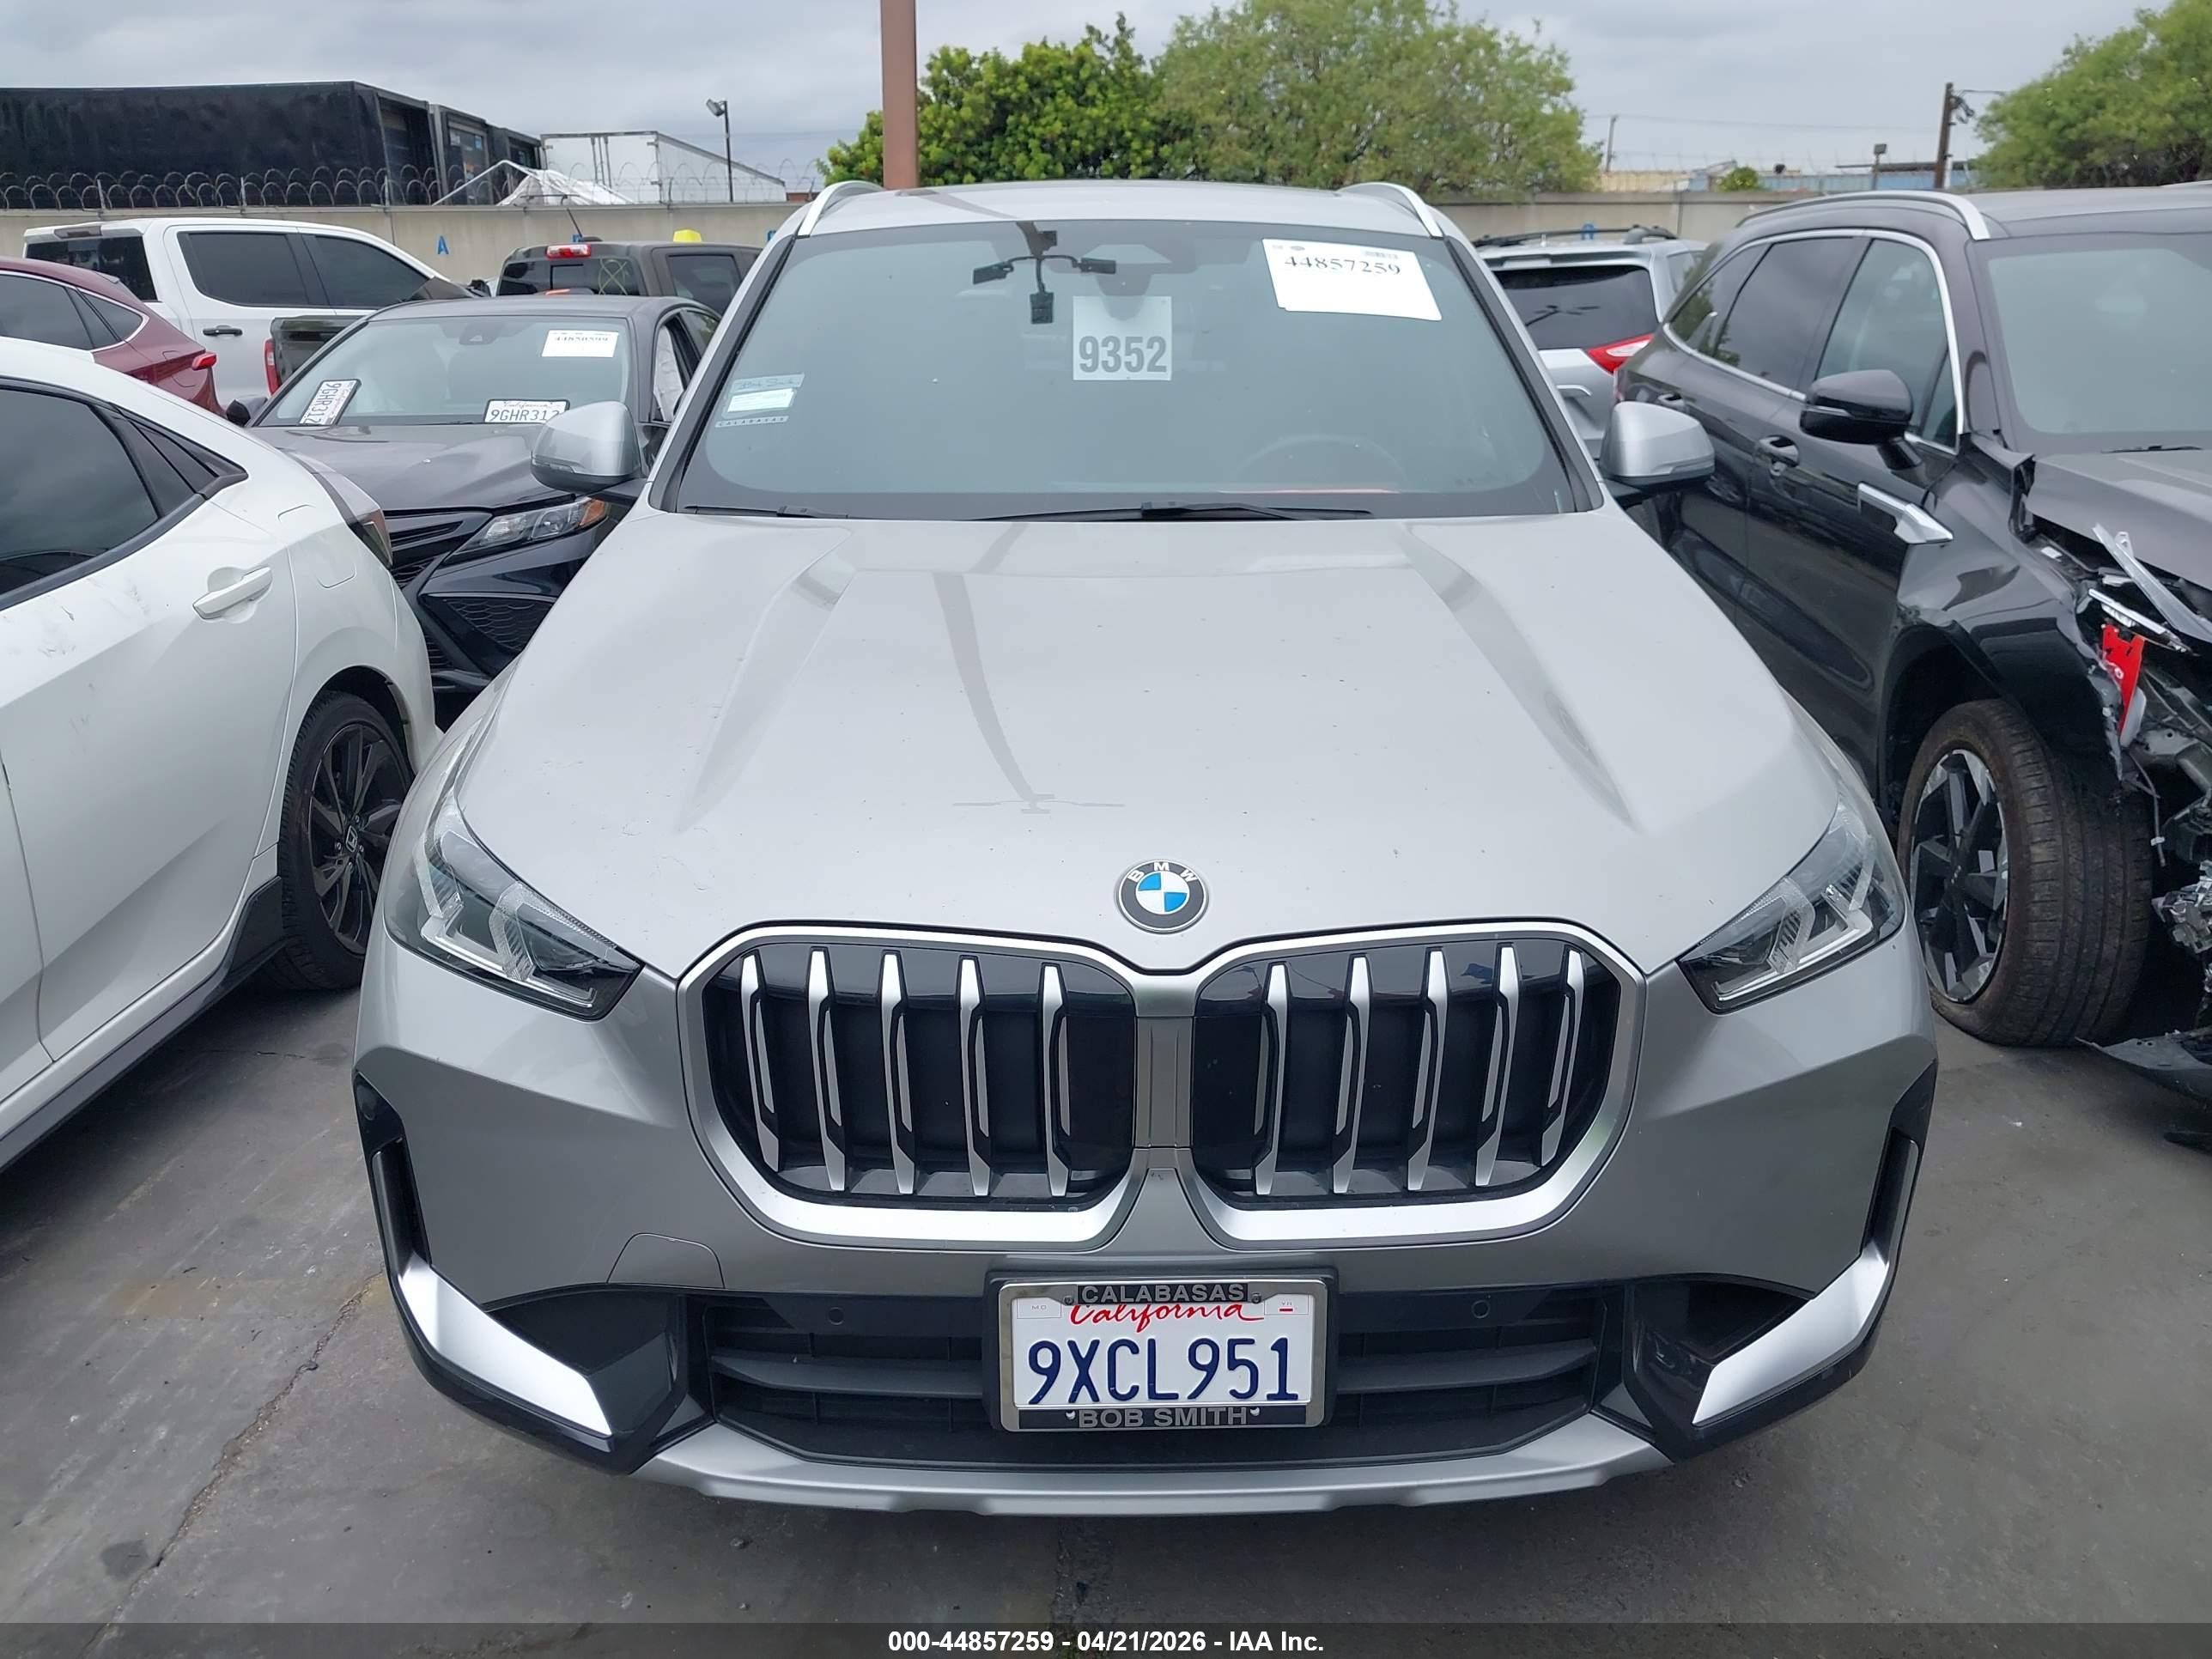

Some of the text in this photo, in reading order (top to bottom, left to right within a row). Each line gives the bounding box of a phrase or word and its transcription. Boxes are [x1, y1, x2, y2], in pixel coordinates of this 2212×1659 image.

[1284, 256, 1401, 276] 44857259
[1079, 335, 1167, 373] 9352
[1127, 861, 1198, 883] BMW
[1081, 1284, 1245, 1304] CALABASAS
[1027, 1336, 1299, 1405] 9XCL951
[1079, 1407, 1246, 1429] BOB SMITH
